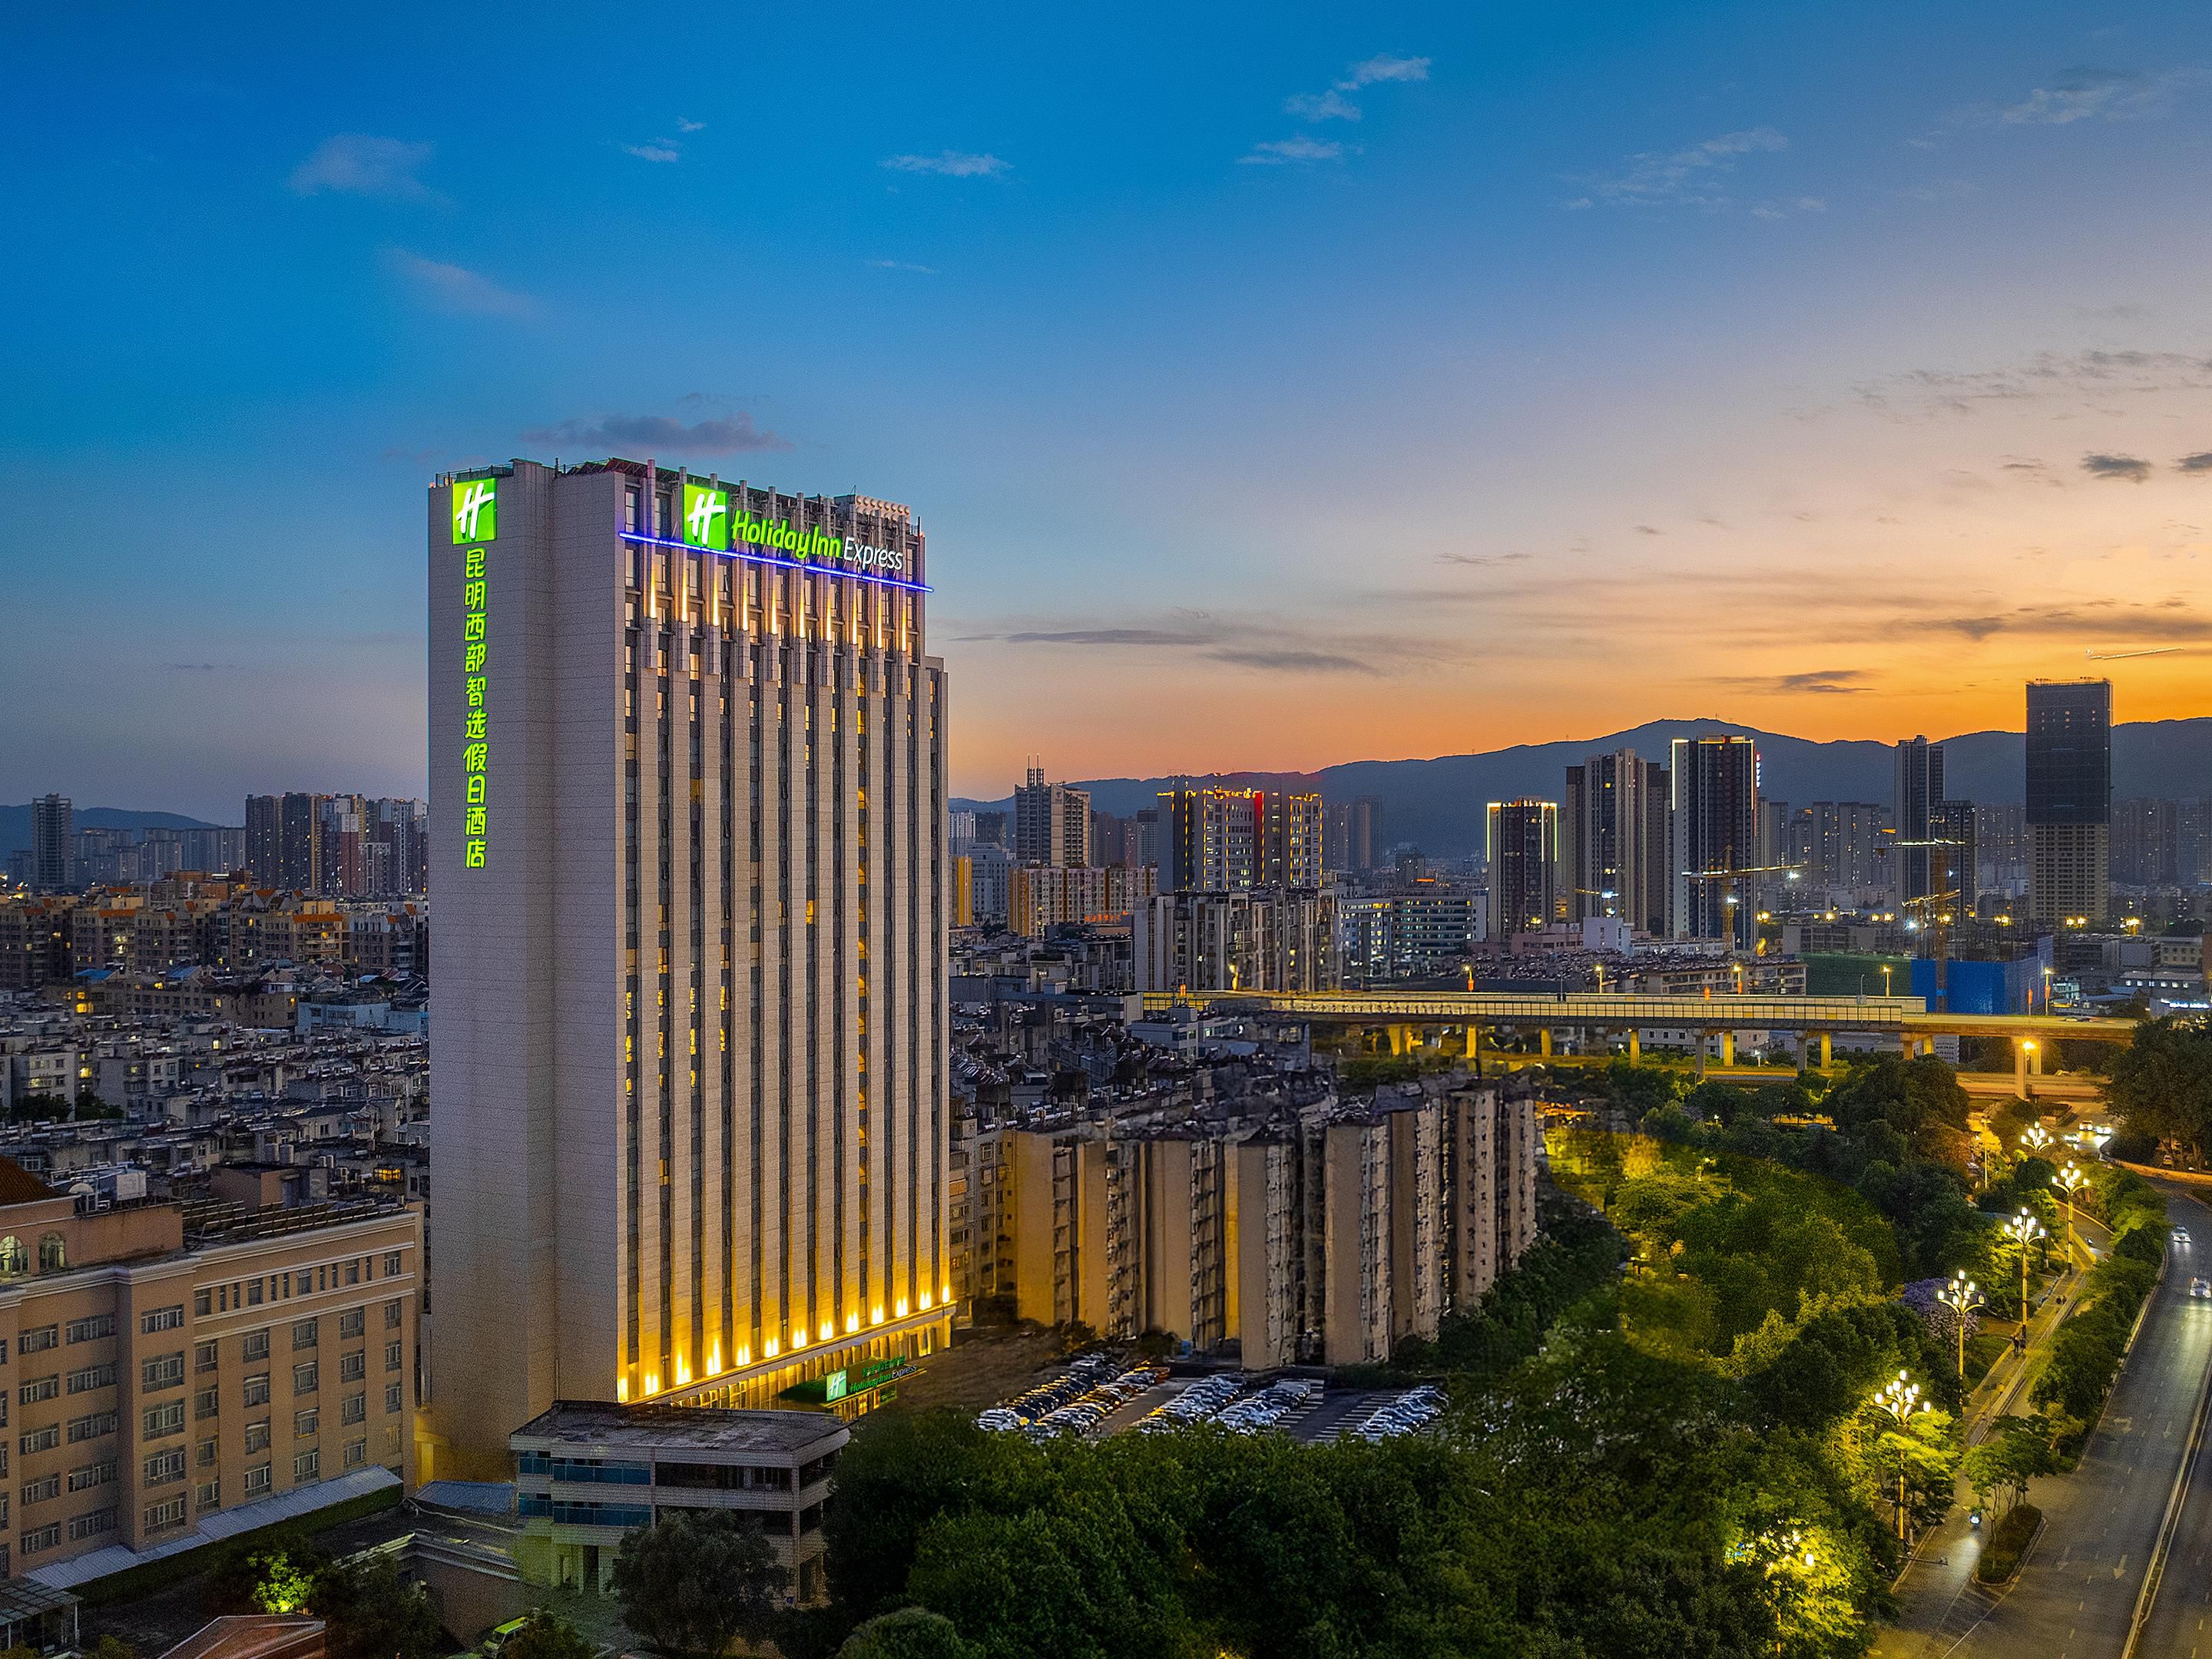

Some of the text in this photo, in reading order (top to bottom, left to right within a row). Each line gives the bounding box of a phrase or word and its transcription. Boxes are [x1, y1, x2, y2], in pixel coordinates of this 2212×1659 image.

[731, 509, 903, 571] Holiday Inn Express
[462, 548, 488, 869] 昆明西部智选假日酒店
[892, 1364, 917, 1379] Express
